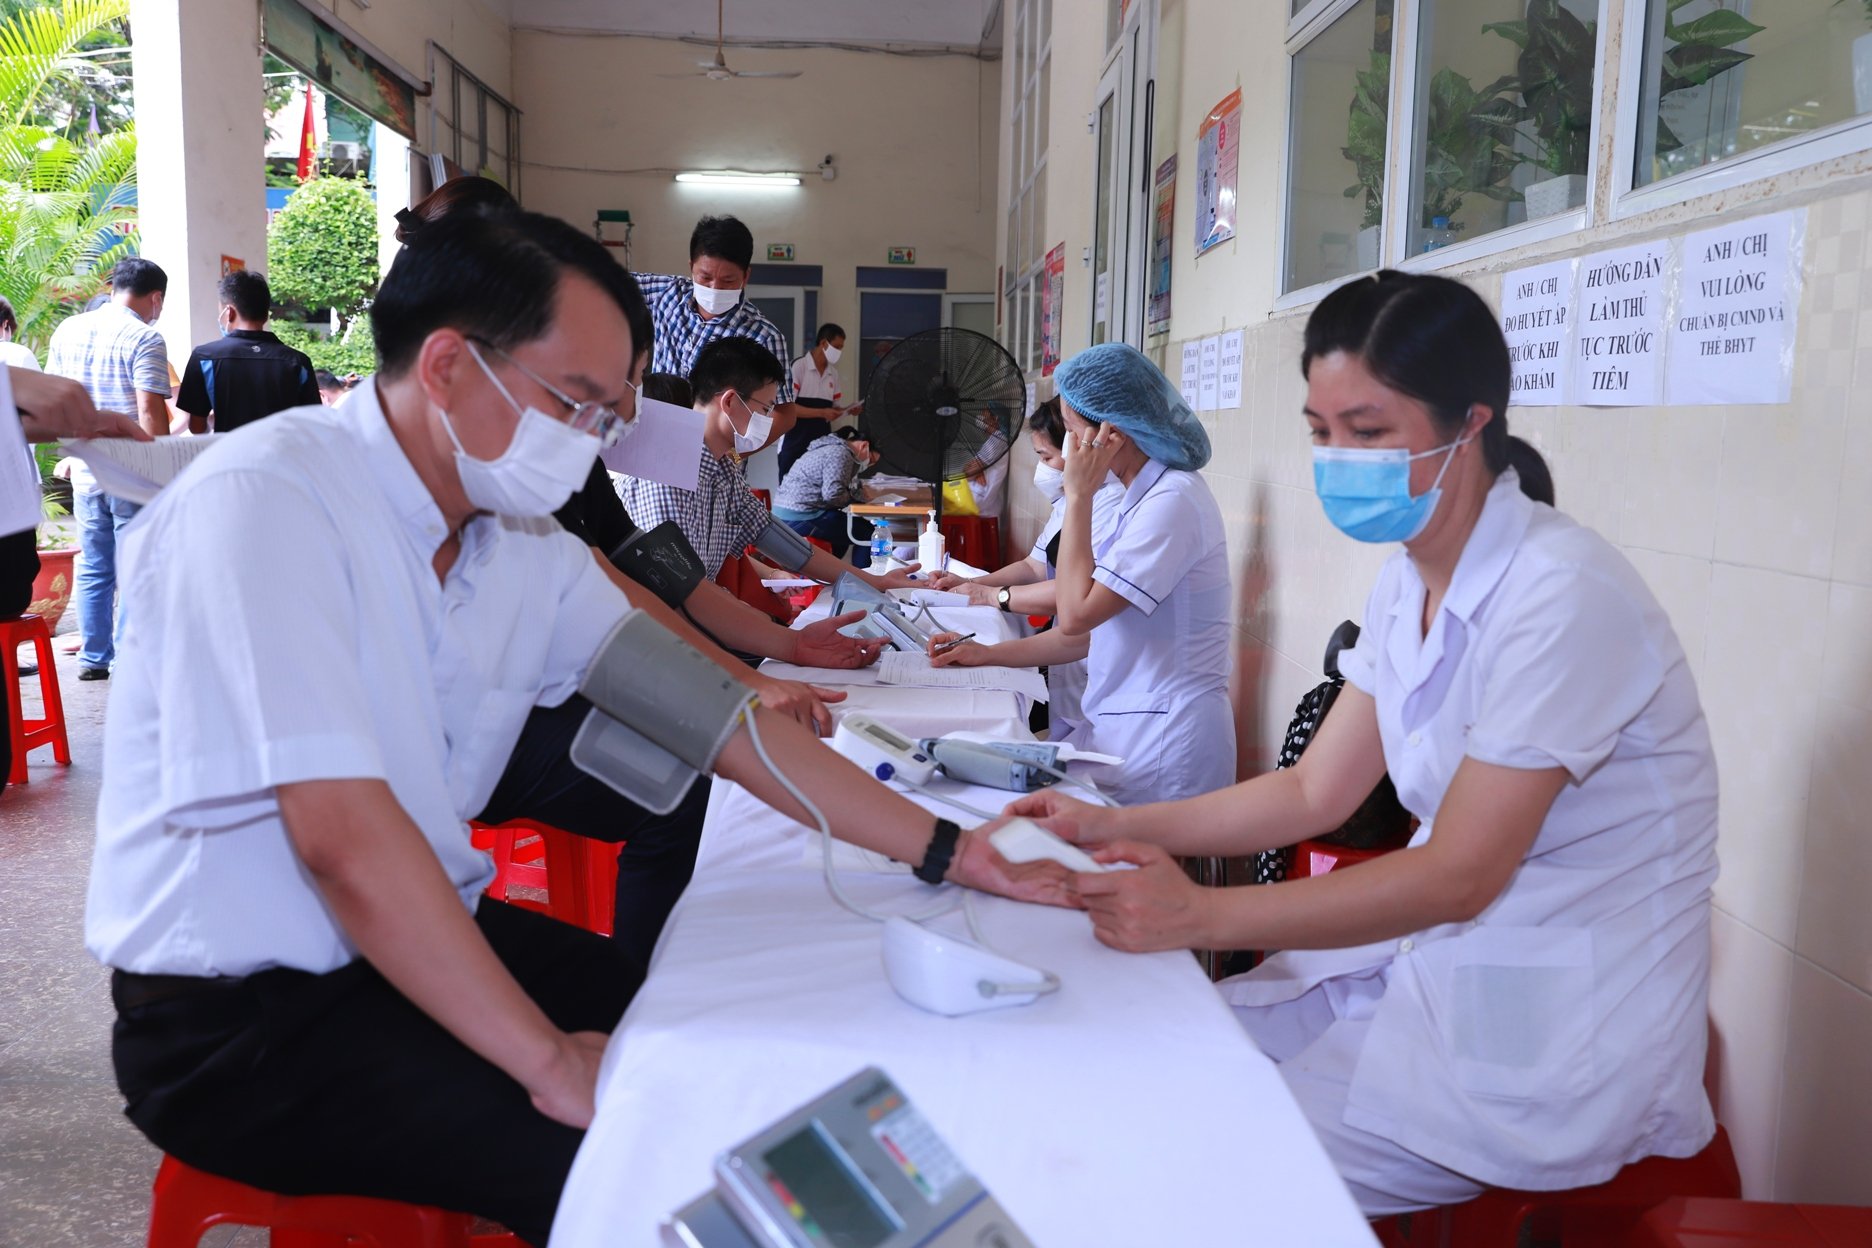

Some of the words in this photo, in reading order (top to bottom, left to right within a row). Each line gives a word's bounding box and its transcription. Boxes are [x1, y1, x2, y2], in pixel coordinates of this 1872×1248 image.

[1703, 241, 1732, 263] ANH
[1742, 233, 1768, 257] CHỊ
[1587, 260, 1631, 288] HƯỚNG
[1633, 253, 1663, 281] DẪN
[1517, 284, 1533, 300] ANH
[1541, 277, 1558, 297] CHỊ
[1701, 279, 1722, 298] VUI
[1725, 270, 1766, 296] LÒNG
[1505, 315, 1516, 333] ĐO
[1518, 307, 1552, 330] HUYẾT
[1553, 302, 1566, 325] ÁP
[1589, 296, 1620, 322] LÀM
[1623, 291, 1647, 318] THỦ
[1718, 313, 1729, 331] BỊ
[1731, 308, 1765, 327] CMND
[1539, 341, 1559, 360] KHI
[1609, 328, 1653, 355] TRƯỚC
[1725, 337, 1756, 354] BHYT
[1524, 368, 1555, 390] KHÁM
[1592, 366, 1630, 390] TIÊM
